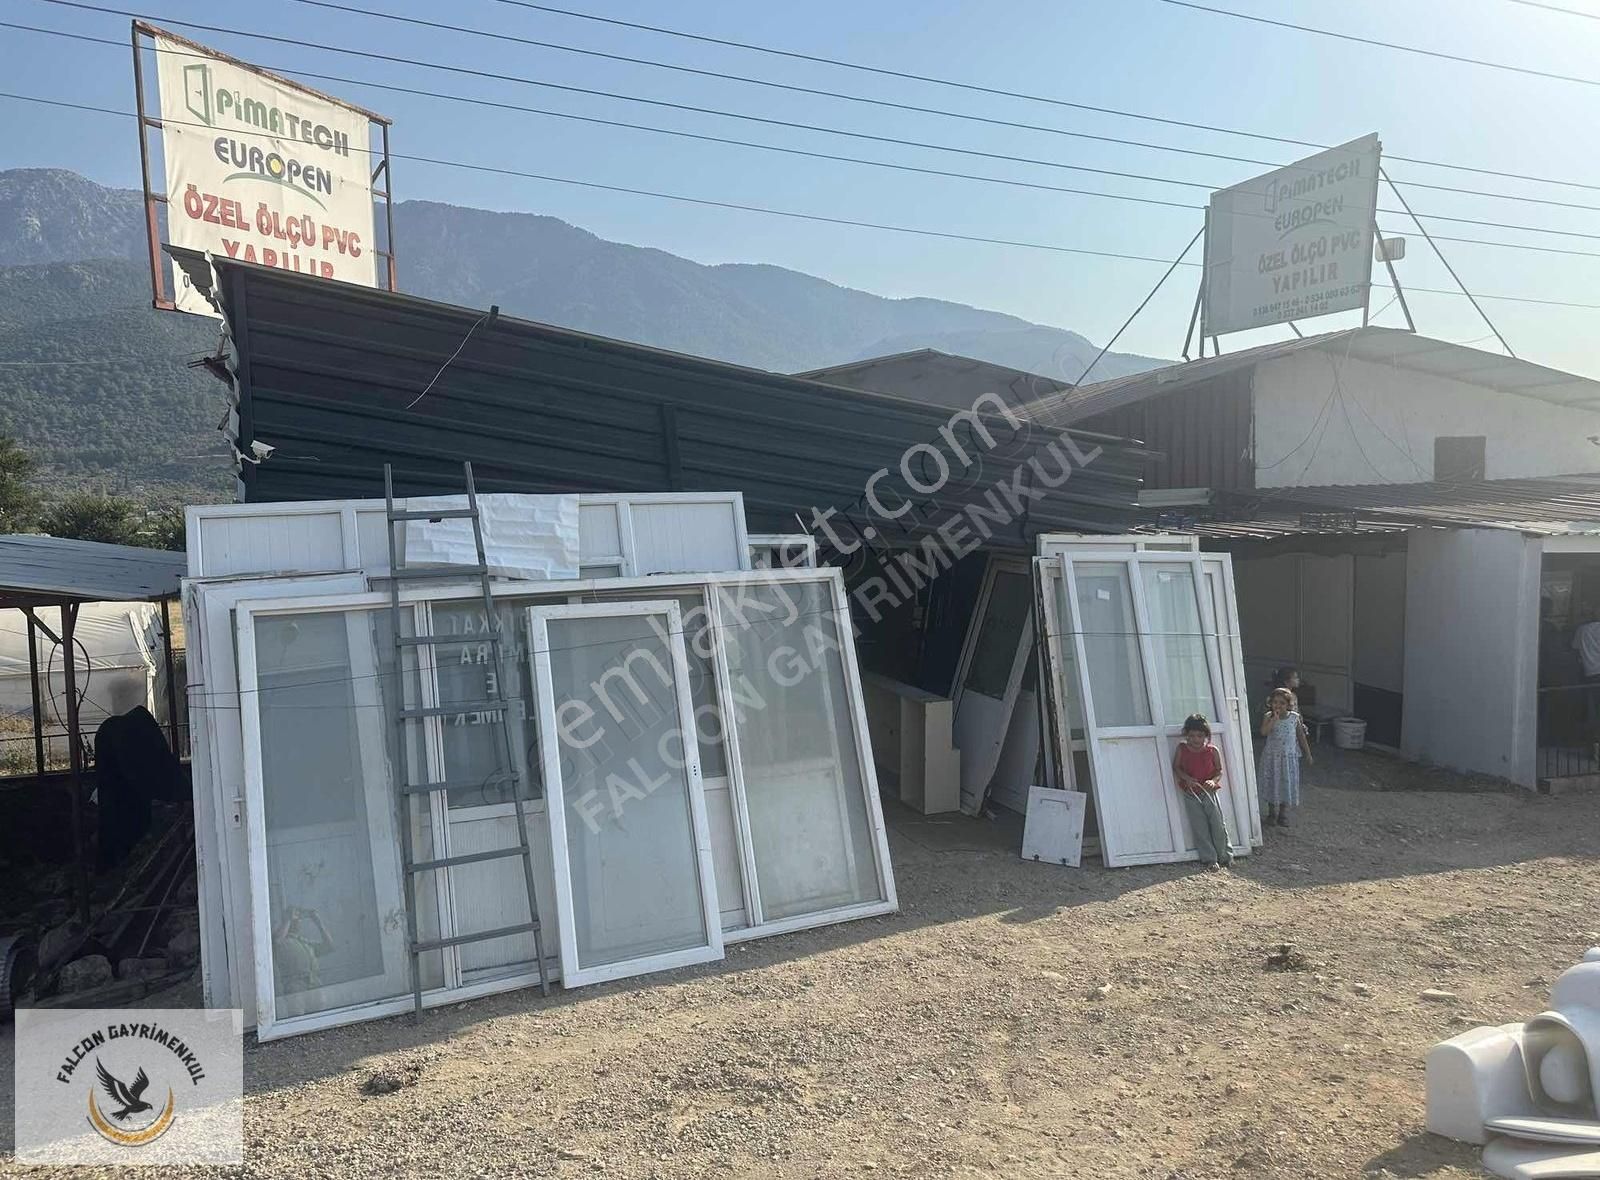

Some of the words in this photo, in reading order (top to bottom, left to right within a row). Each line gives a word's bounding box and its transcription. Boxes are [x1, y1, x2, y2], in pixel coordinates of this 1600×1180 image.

[214, 137, 332, 195] EUROPEN
[184, 183, 250, 232] ÖZEL
[256, 202, 316, 249] ÖLÇÜ
[322, 224, 362, 258] PVC
[1274, 194, 1343, 232] EUROPEN
[1257, 251, 1288, 274] ÖZEL
[1331, 230, 1361, 254] PVC
[1272, 262, 1338, 294] YAPILIR
